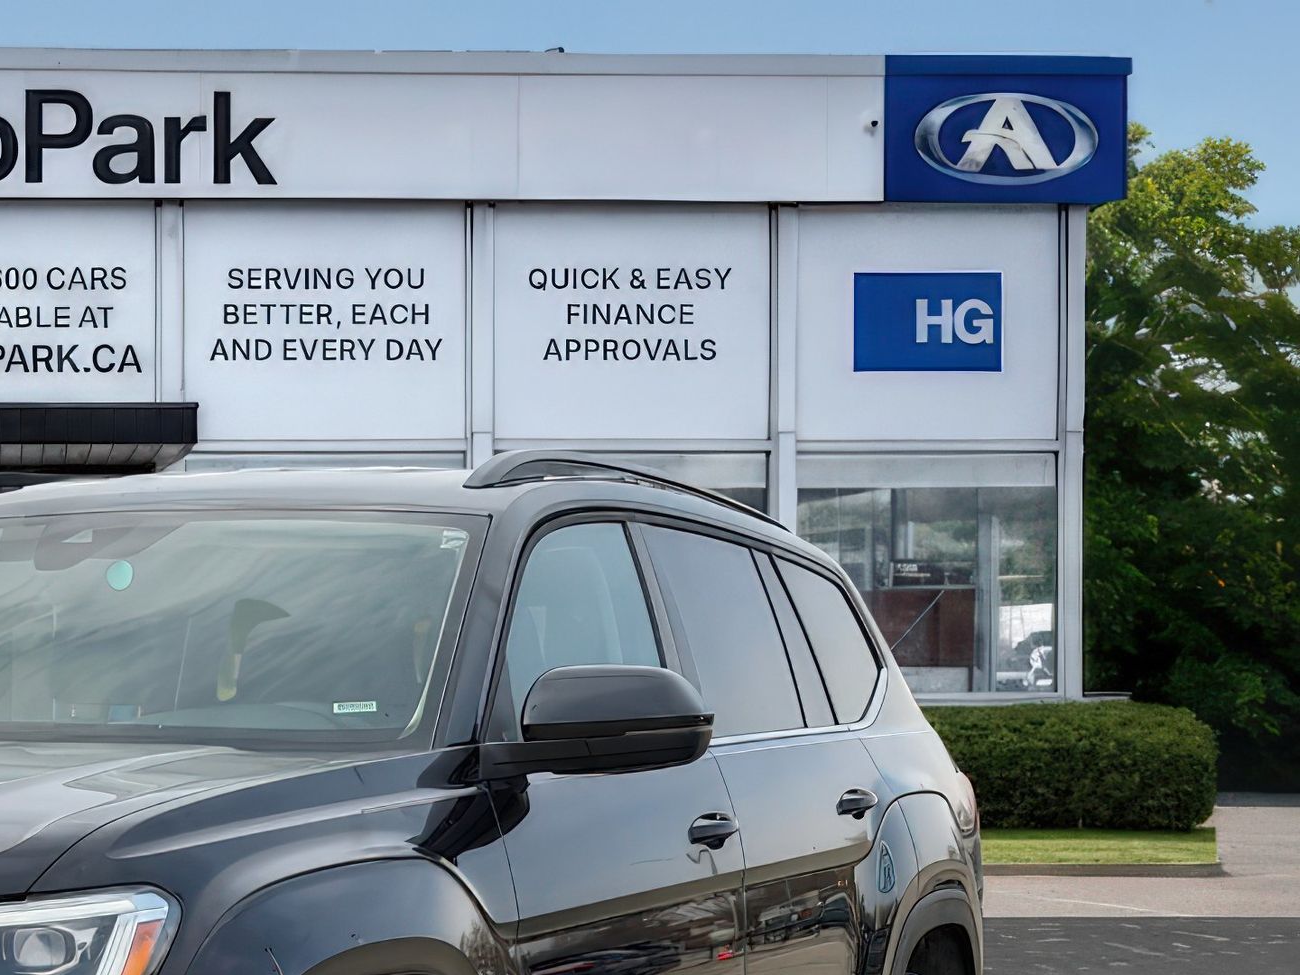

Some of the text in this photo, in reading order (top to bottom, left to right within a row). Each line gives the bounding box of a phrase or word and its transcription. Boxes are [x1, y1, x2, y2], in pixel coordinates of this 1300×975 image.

[47, 266, 128, 291] CARS
[227, 267, 425, 290] SERVING YOU
[528, 267, 732, 292] QUICK & EASY
[78, 306, 114, 329] AT
[223, 303, 430, 330] BETTER, EACH
[567, 303, 694, 326] FINANCE
[915, 298, 994, 344] HG
[209, 338, 443, 362] AND EVERY DAY
[542, 338, 717, 362] APPROVALS
